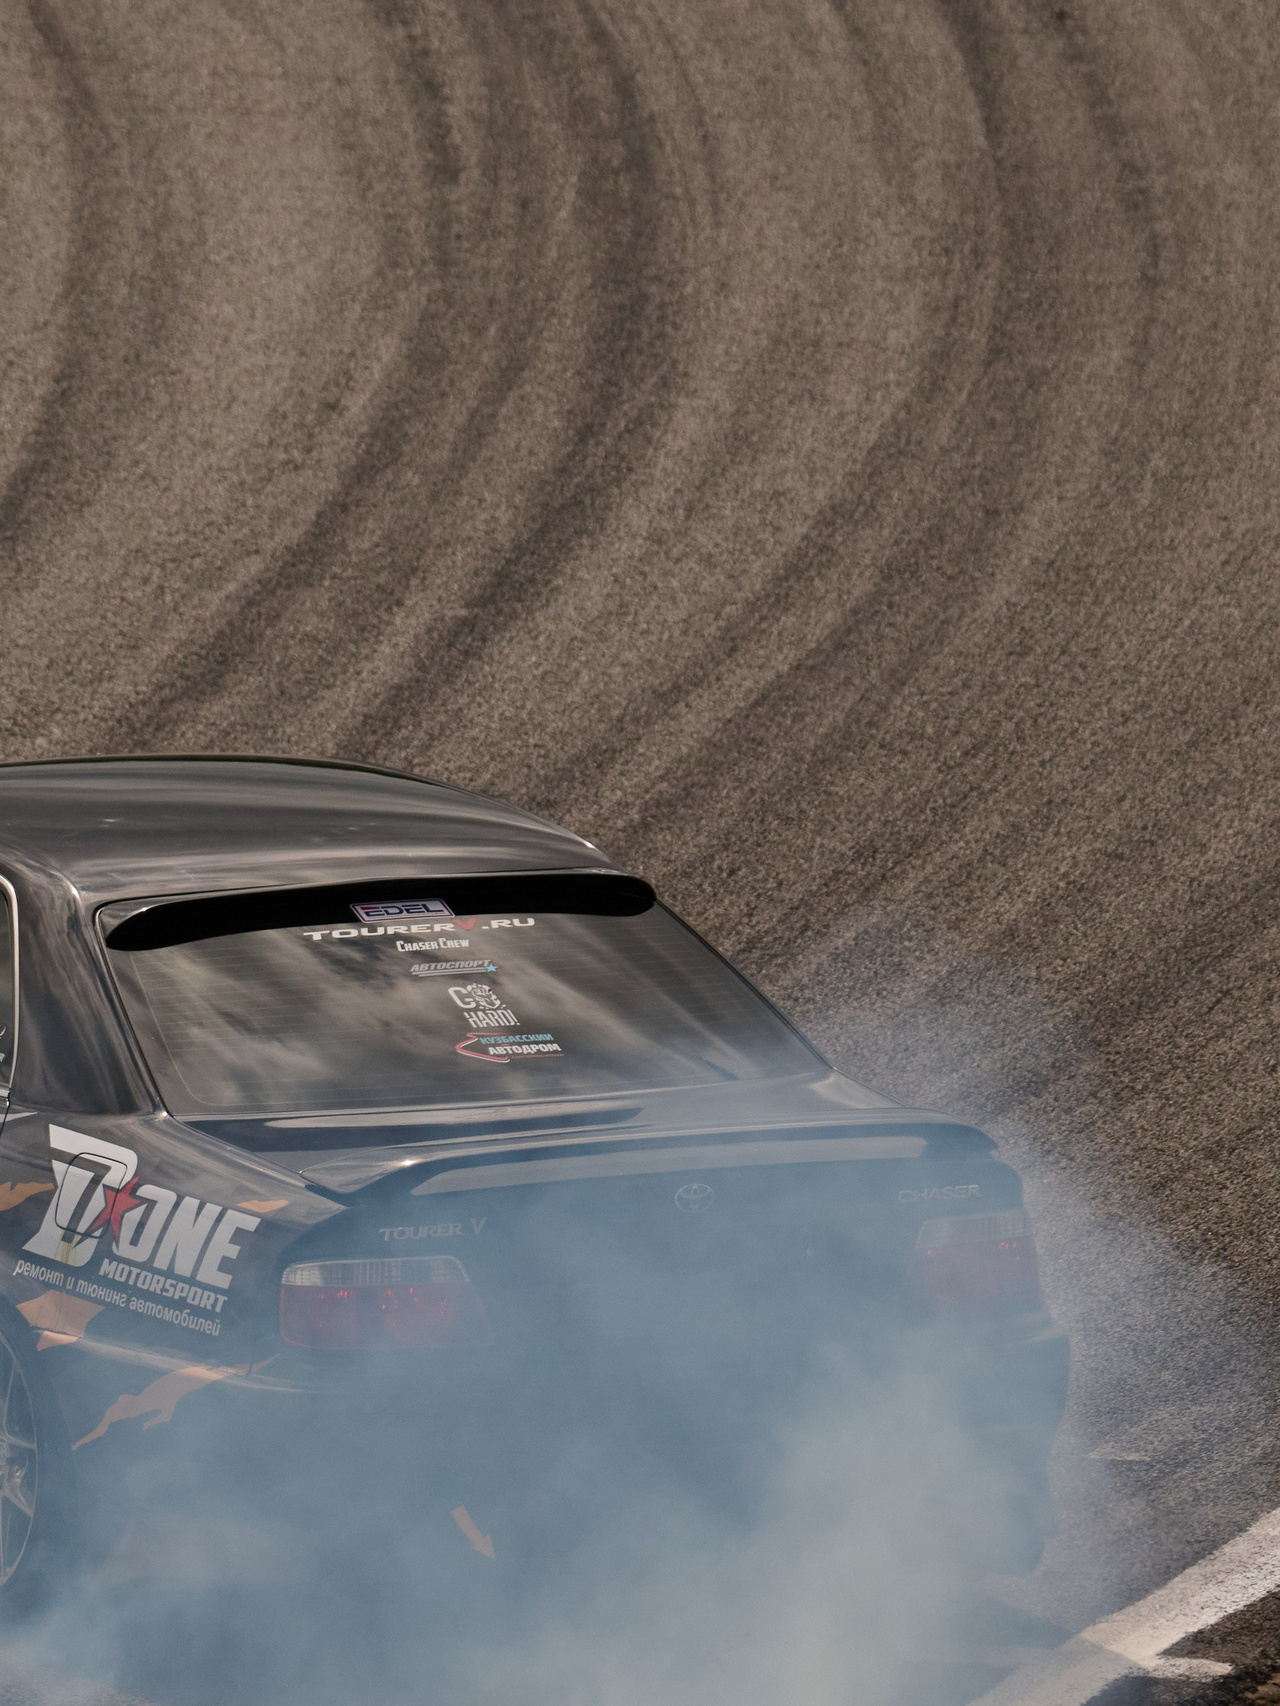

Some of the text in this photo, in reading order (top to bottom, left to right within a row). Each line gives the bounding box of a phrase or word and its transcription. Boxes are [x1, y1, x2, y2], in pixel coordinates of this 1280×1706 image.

[360, 903, 445, 917] EDEL
[410, 959, 491, 972] АВТОСПОРТ
[488, 1043, 562, 1056] АВТОДРОМ
[898, 1184, 982, 1203] CHASER
[379, 1216, 488, 1242] TOURER V
[99, 1258, 228, 1313] MOTORSPORT
[13, 1259, 64, 1288] ремонт
[65, 1275, 74, 1291] и
[129, 1294, 221, 1337] автомобилей
